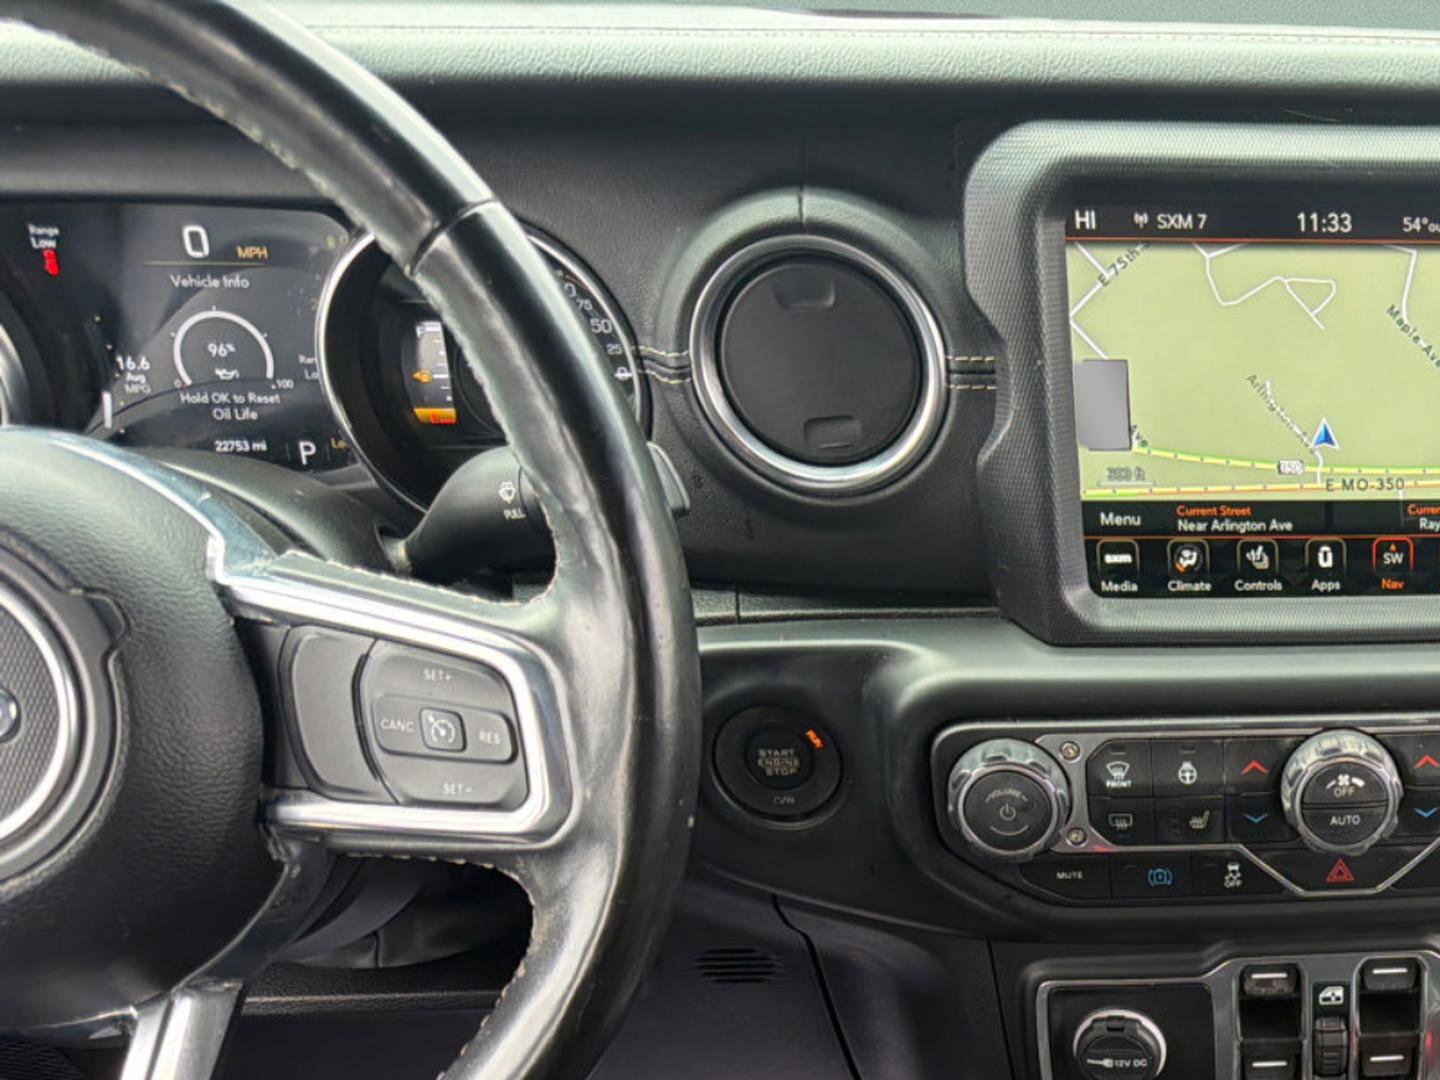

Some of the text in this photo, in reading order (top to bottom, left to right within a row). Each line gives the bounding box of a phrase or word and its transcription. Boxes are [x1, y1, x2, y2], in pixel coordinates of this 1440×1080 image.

[1074, 210, 1096, 230] HI
[1157, 213, 1208, 230] SXM 7
[1297, 212, 1353, 234] 11:33
[182, 225, 209, 258] 0
[236, 246, 268, 259] MPH
[170, 275, 250, 290] Vehicle Info
[590, 317, 613, 333] 50
[1386, 304, 1421, 343] Maple
[116, 356, 151, 371] 16.6
[180, 392, 282, 405] Hold OK to Reset
[213, 408, 259, 421] Oil Life
[252, 440, 267, 452] mi
[299, 442, 316, 465] P
[1325, 478, 1335, 492] E
[1176, 505, 1252, 517] Current Street
[1100, 512, 1142, 527] Menu
[1177, 519, 1293, 534] Near Arlington Ave
[1382, 552, 1404, 565] SW
[1101, 581, 1138, 593] Media
[1167, 580, 1212, 592] Climate
[1234, 579, 1283, 591] Controls
[1311, 579, 1341, 592] Apps
[1381, 579, 1405, 590] Nav
[380, 718, 415, 733] CANC
[478, 731, 502, 745] RES
[1333, 787, 1355, 798] OFF
[1329, 815, 1361, 827] AUTO
[1056, 870, 1083, 880] MUTE
